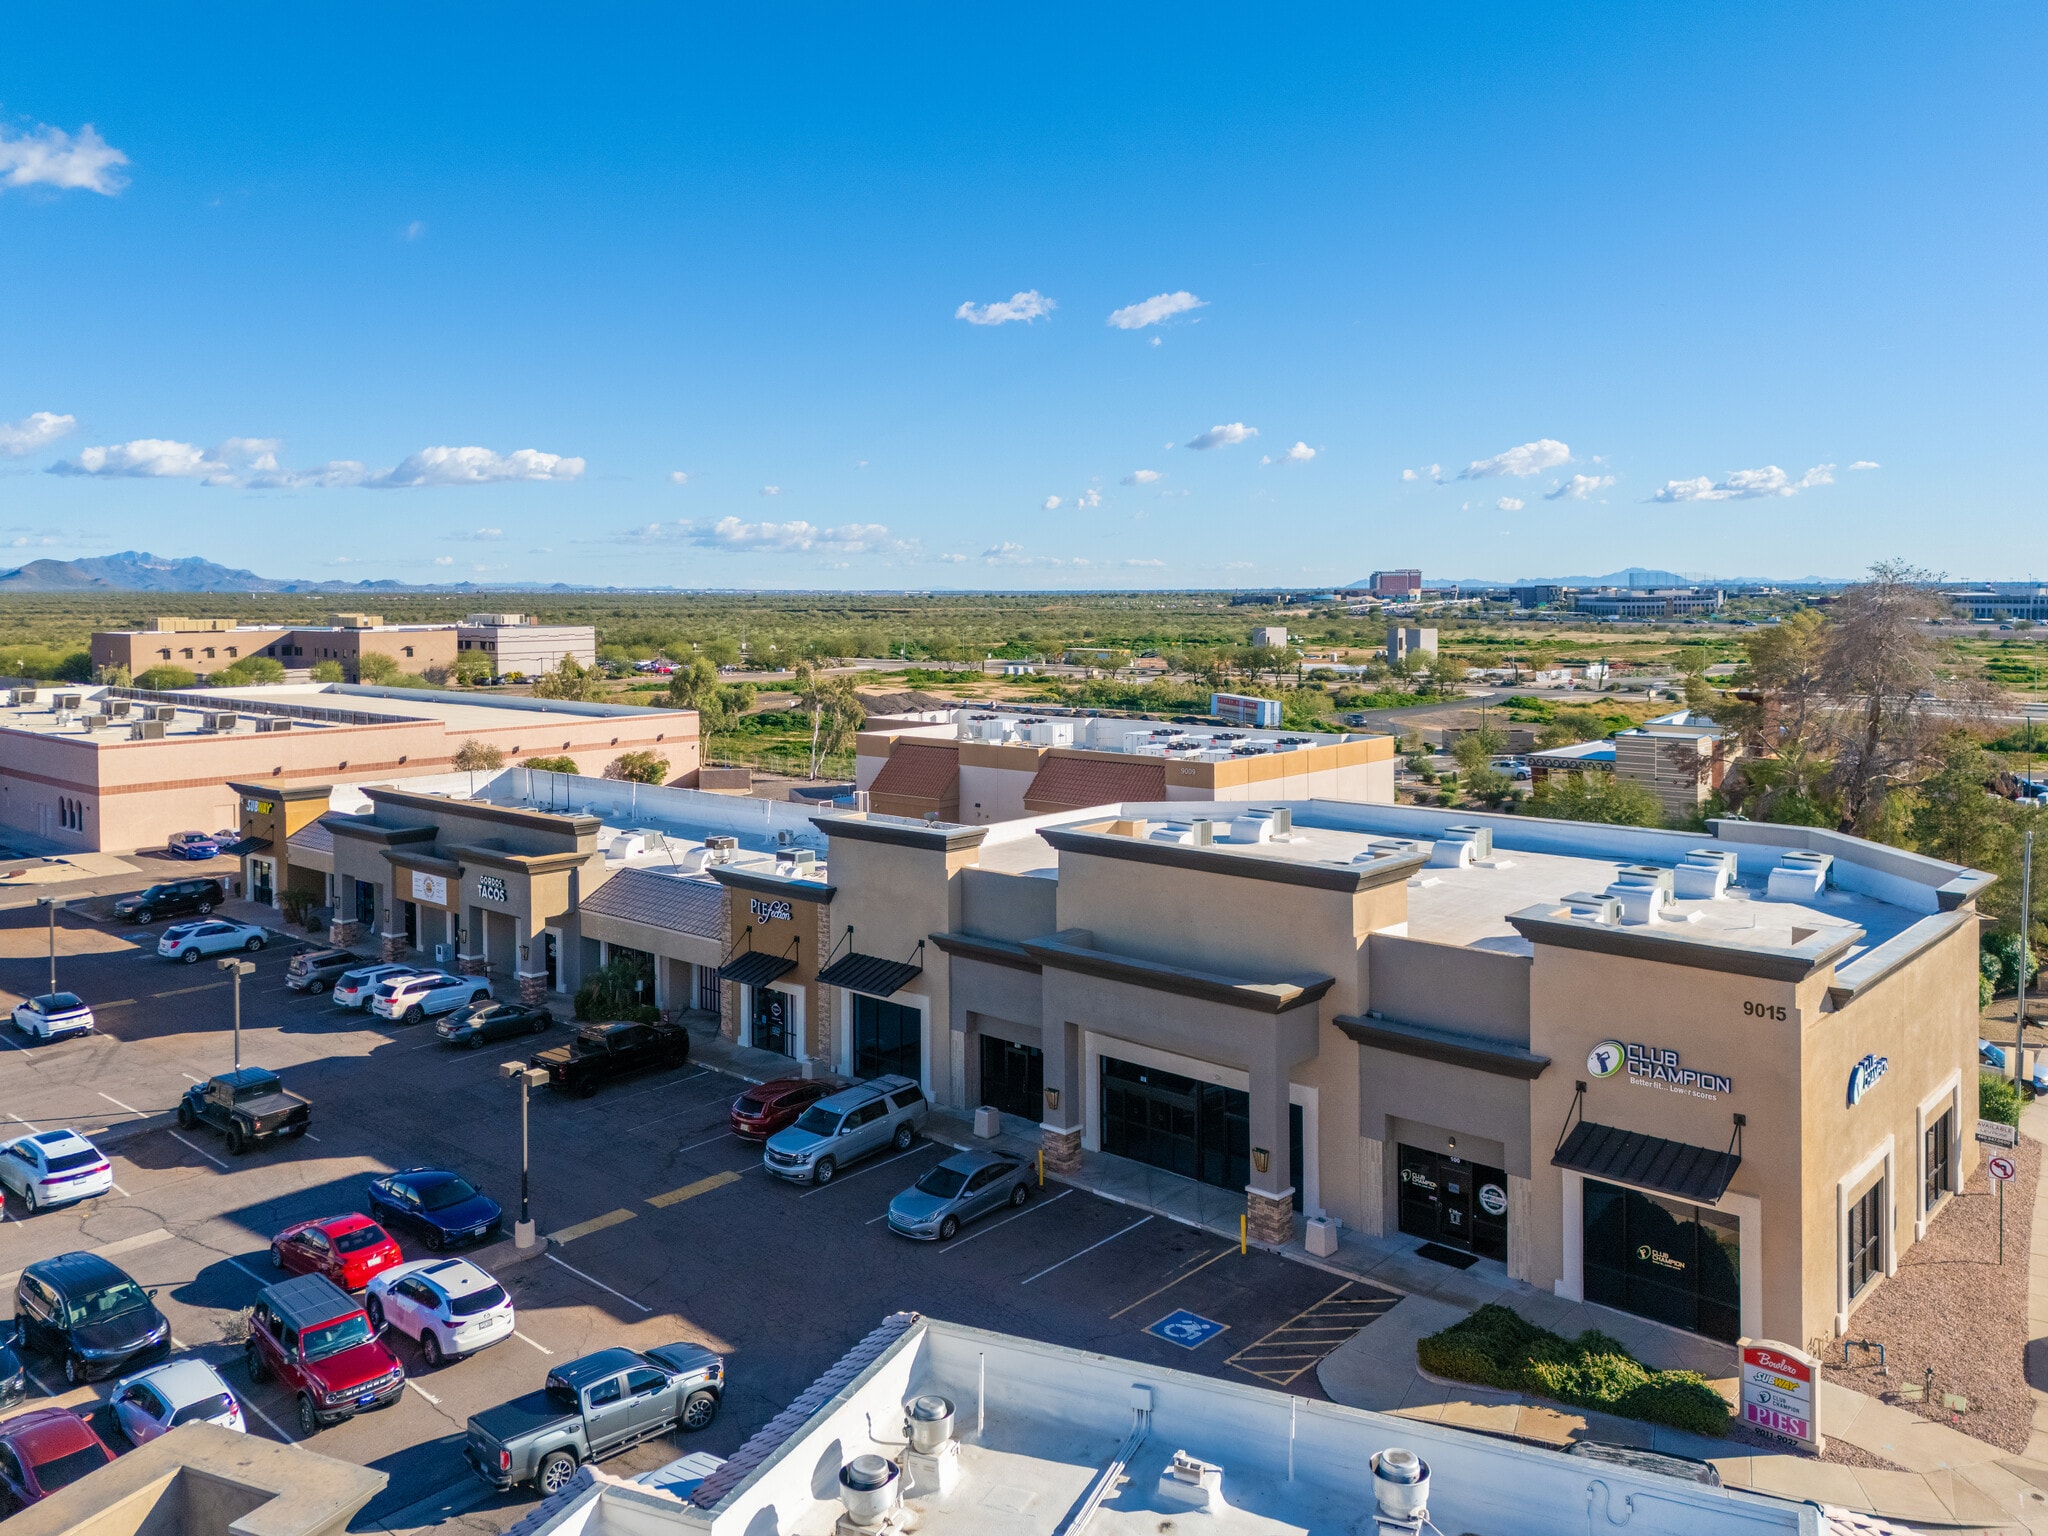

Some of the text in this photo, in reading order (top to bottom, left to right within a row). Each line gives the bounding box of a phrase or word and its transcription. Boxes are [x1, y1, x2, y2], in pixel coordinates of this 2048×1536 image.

[1180, 767, 1196, 775] 9009
[246, 799, 273, 814] SUBWAY
[480, 875, 503, 888] GORDOS
[477, 884, 505, 902] TACOS
[1743, 1000, 1787, 1021] 9015
[1627, 1044, 1678, 1068] CLUB
[1627, 1060, 1731, 1094] CHAMPION
[1630, 1077, 1652, 1088] Better
[1669, 1084, 1692, 1096] Lower
[1692, 1091, 1717, 1101] scores
[1977, 1121, 2012, 1133] AVAILABLE
[1652, 1249, 1669, 1259] CLUB
[1652, 1254, 1685, 1268] CHAMPION
[1757, 1352, 1797, 1375] Bowlero
[1753, 1371, 1800, 1392] SUBWAY
[1772, 1395, 1787, 1404] CLUB
[1772, 1401, 1800, 1413] CHAMPION
[1756, 1407, 1800, 1435] PIES
[1754, 1427, 1799, 1446] 9011-9027
